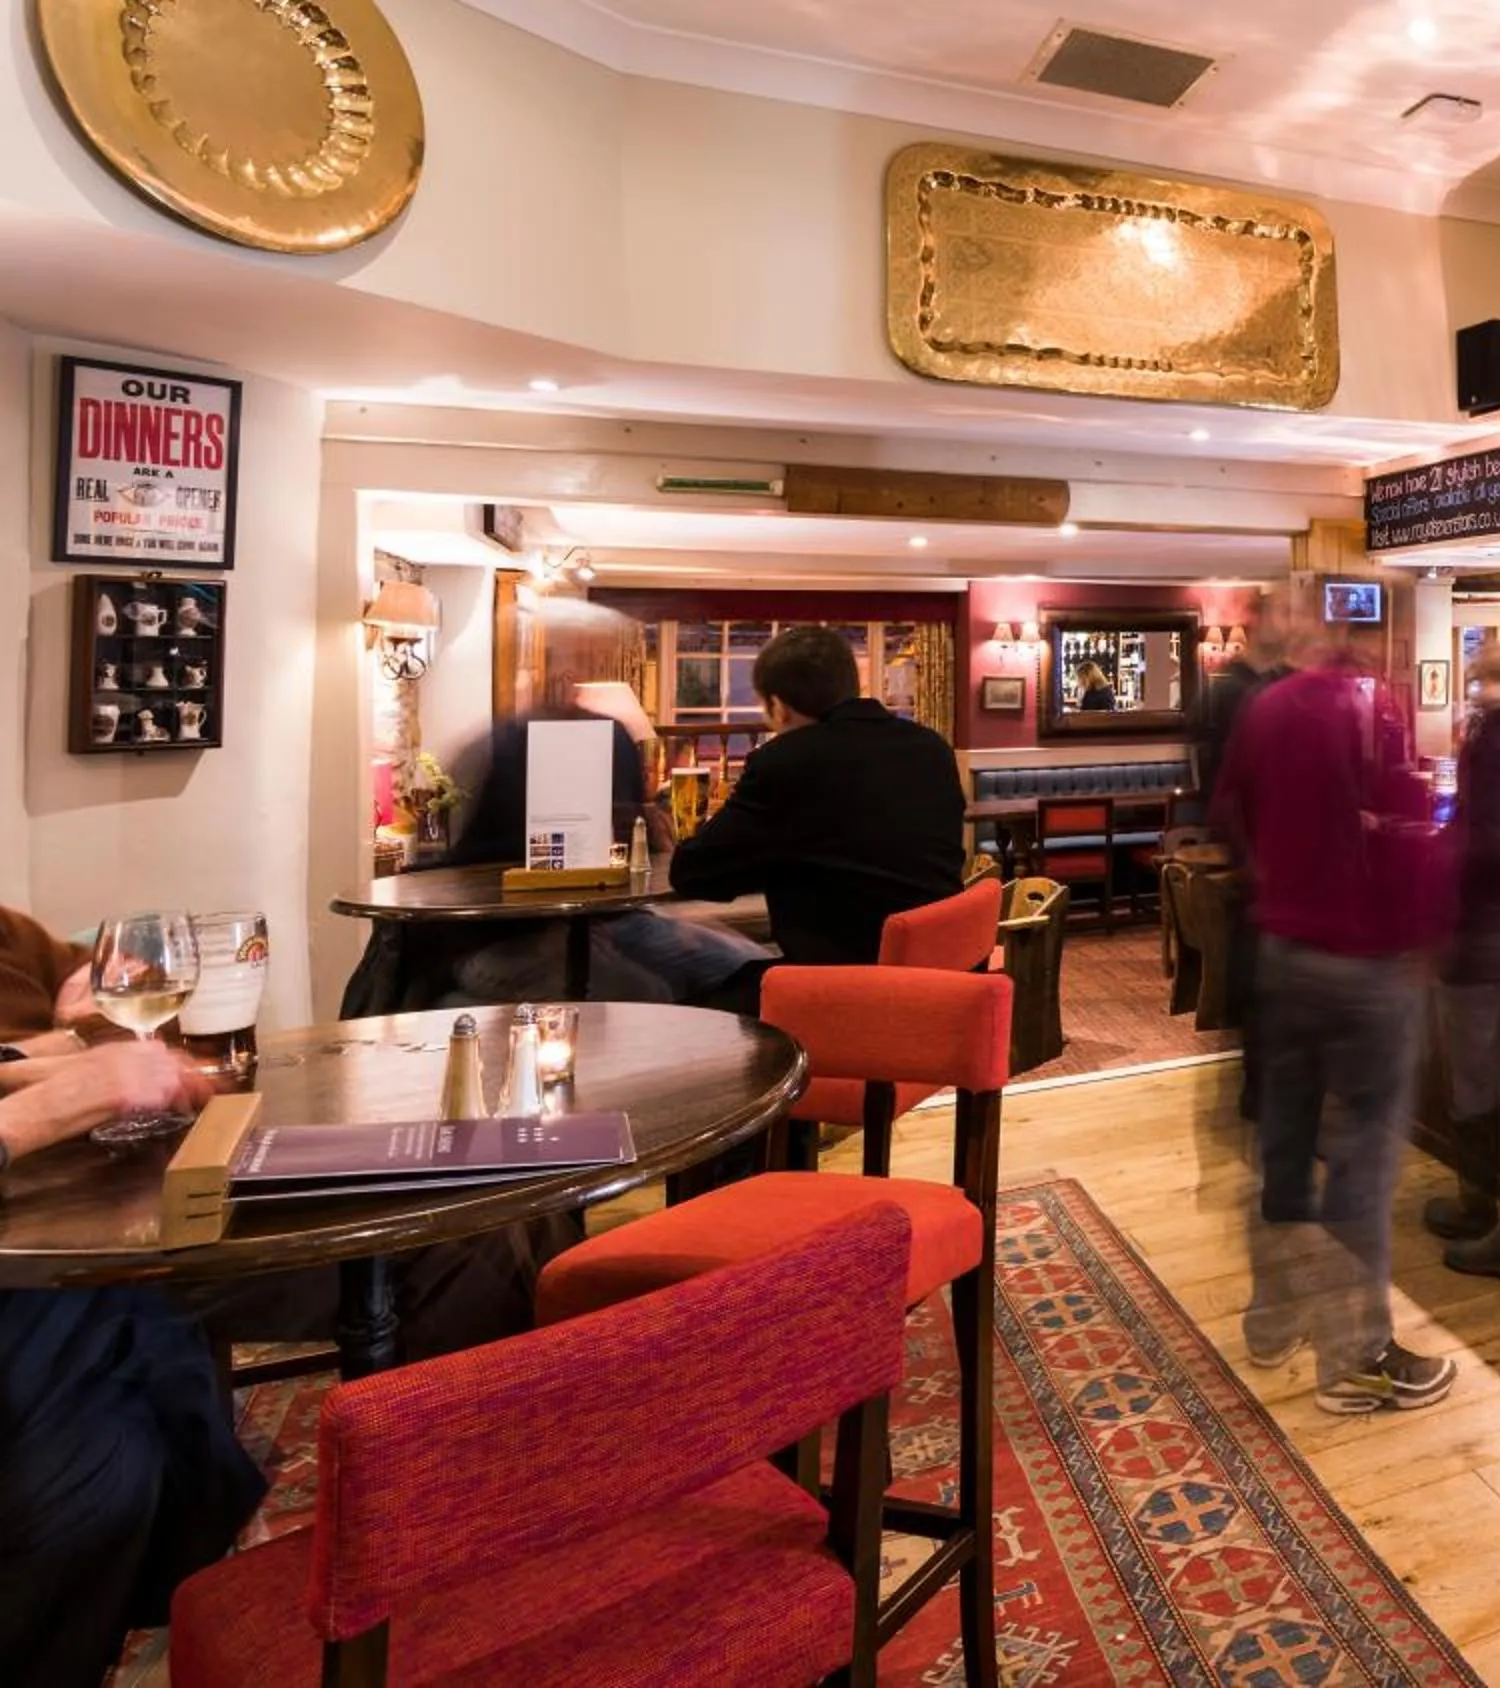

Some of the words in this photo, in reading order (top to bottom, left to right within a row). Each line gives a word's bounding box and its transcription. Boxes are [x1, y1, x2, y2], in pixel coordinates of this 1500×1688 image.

[121, 379, 191, 404] OUR
[78, 397, 224, 470] DINNERS
[133, 467, 160, 477] ARE
[165, 470, 174, 478] A
[76, 477, 109, 503] REAL
